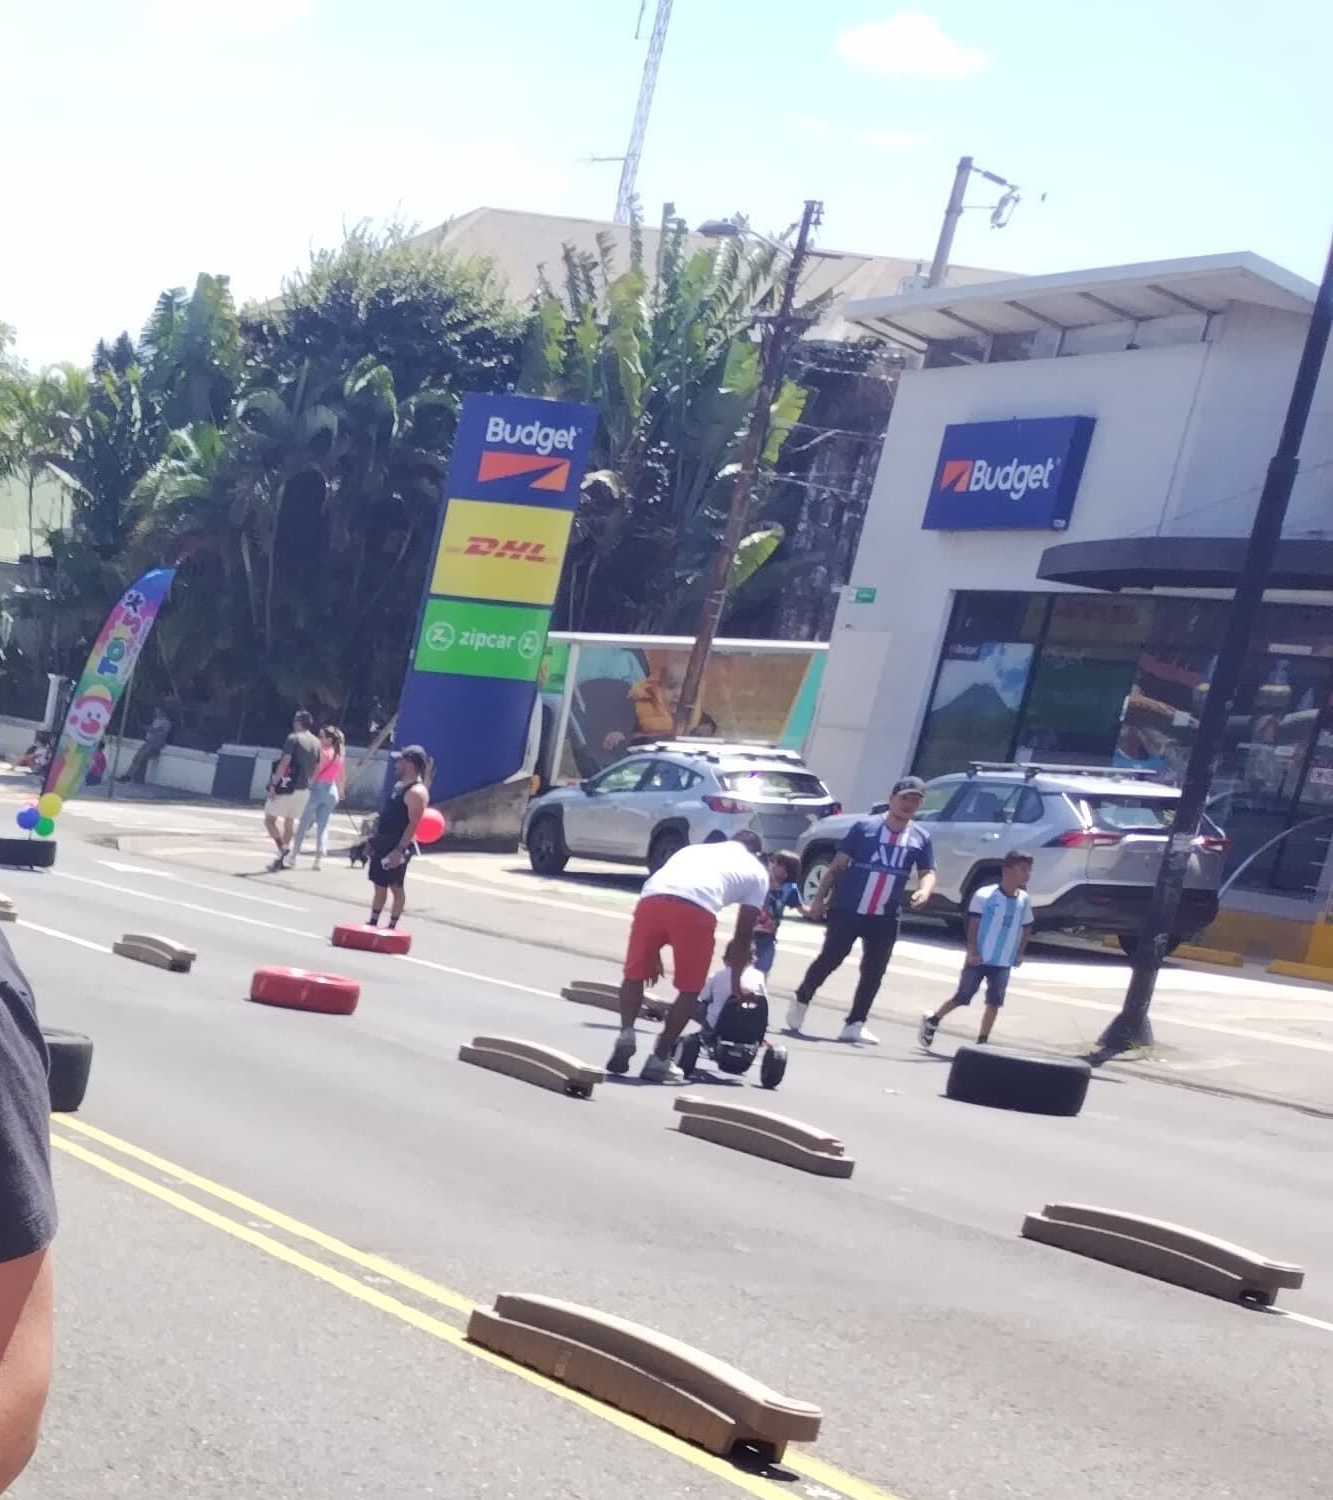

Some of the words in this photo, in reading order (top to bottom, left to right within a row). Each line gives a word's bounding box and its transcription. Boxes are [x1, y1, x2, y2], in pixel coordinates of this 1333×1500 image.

[486, 416, 578, 456] Budget
[969, 457, 1055, 501] Budget
[462, 536, 548, 563] DHL
[458, 625, 516, 652] zipcar
